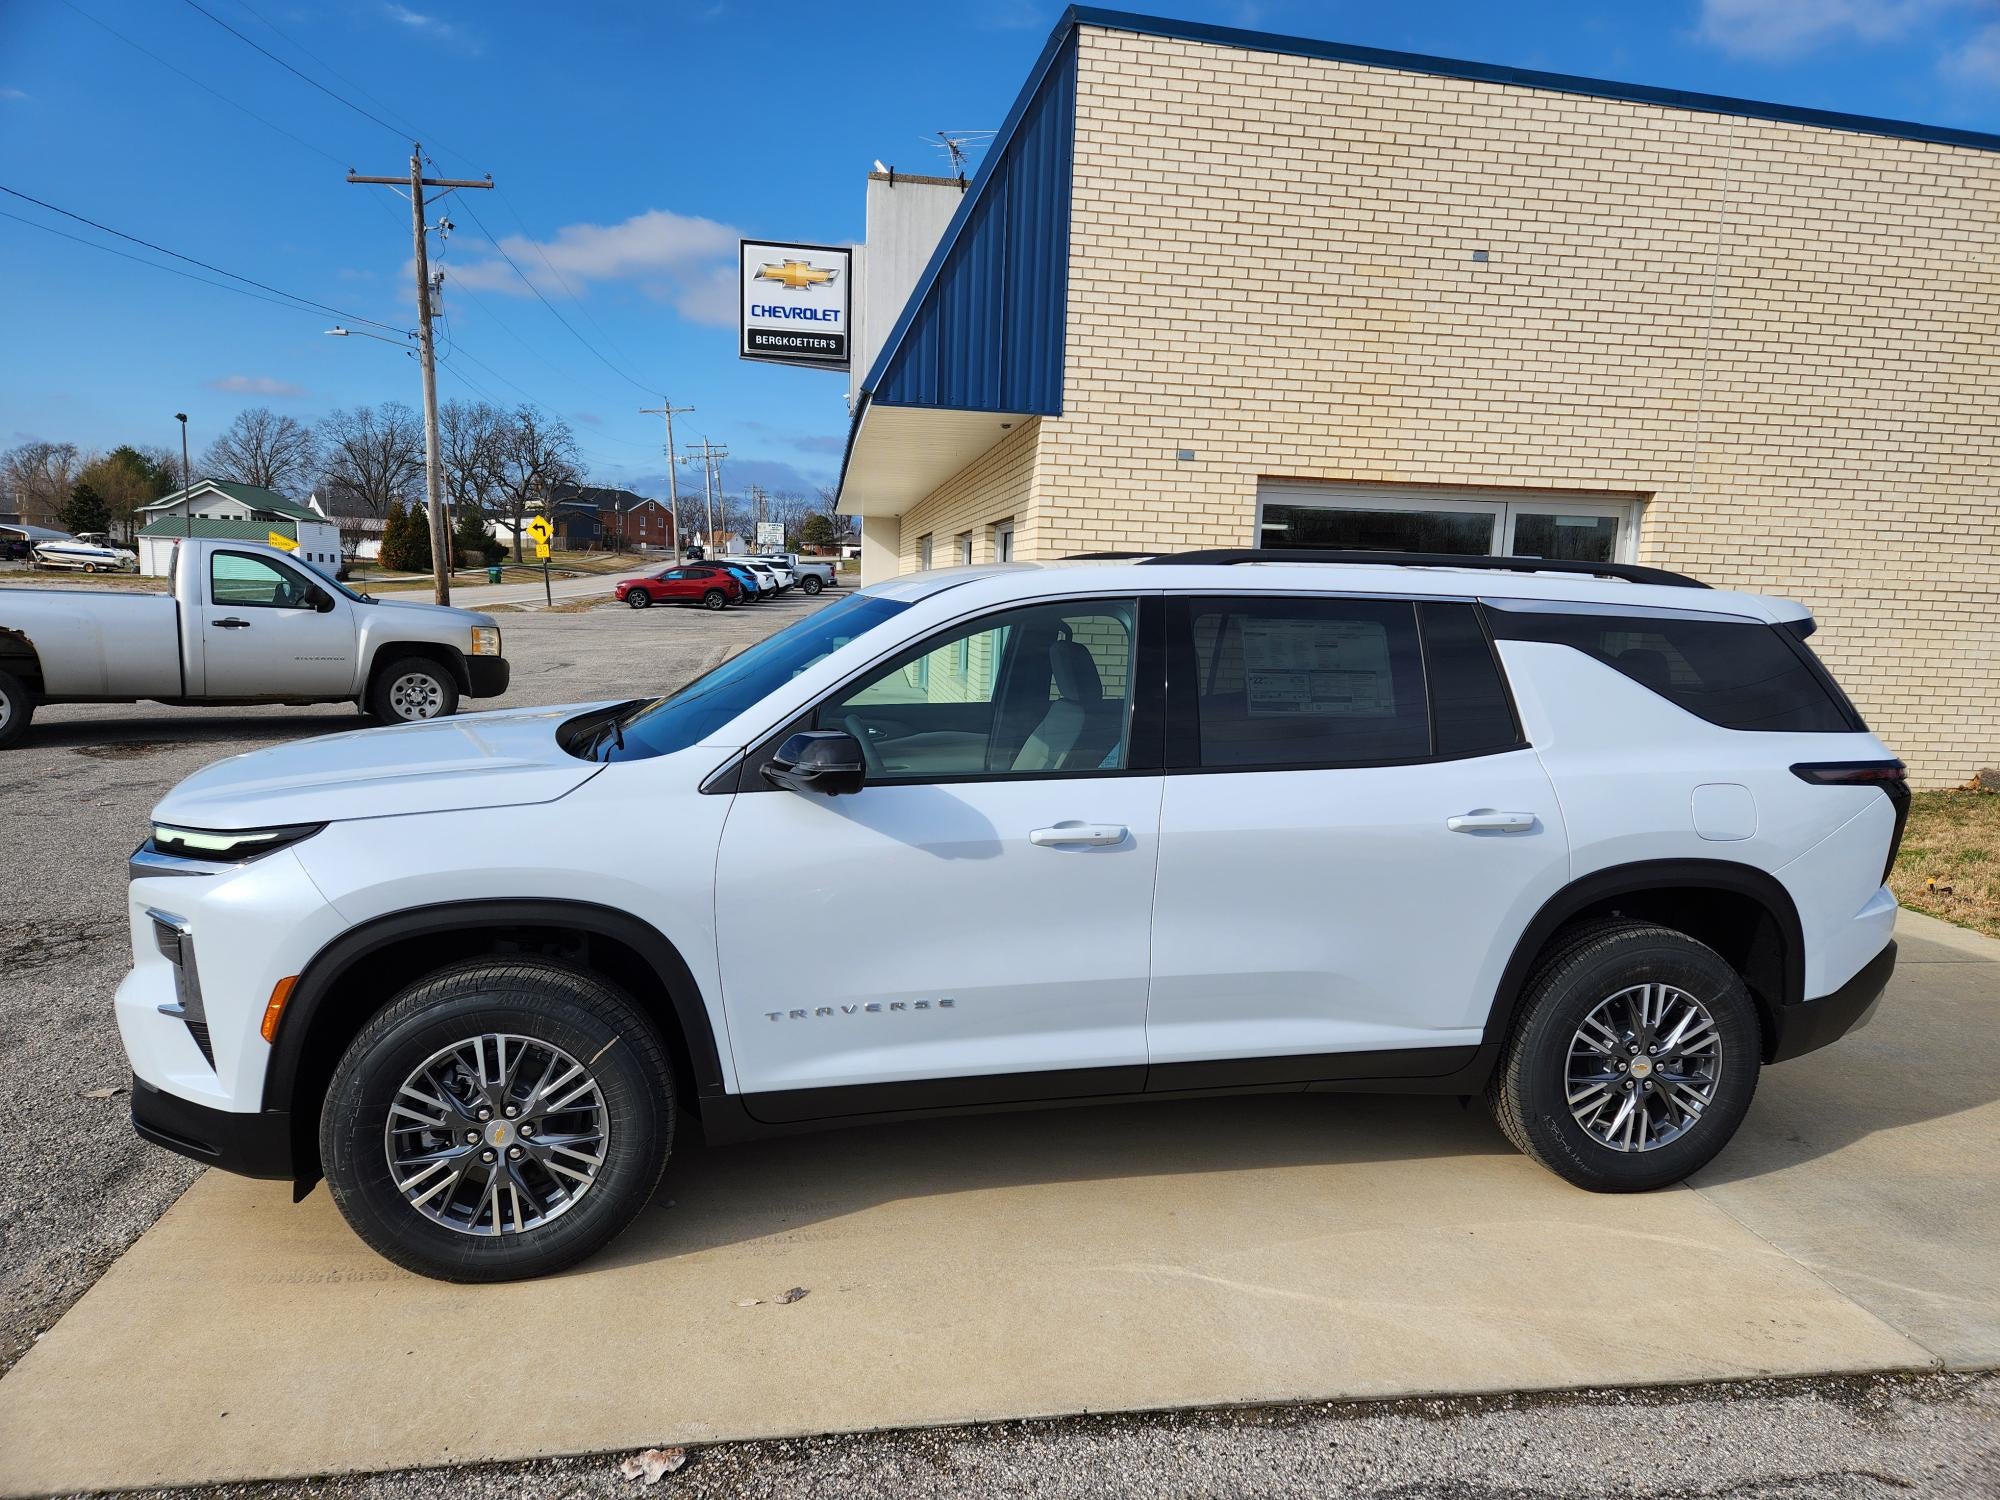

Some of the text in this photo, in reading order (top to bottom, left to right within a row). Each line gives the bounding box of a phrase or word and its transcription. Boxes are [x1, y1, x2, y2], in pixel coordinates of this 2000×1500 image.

[751, 304, 841, 322] CHEVROLET
[755, 335, 836, 349] BERGKOETTER'S
[764, 998, 955, 1022] TRAVERSE
